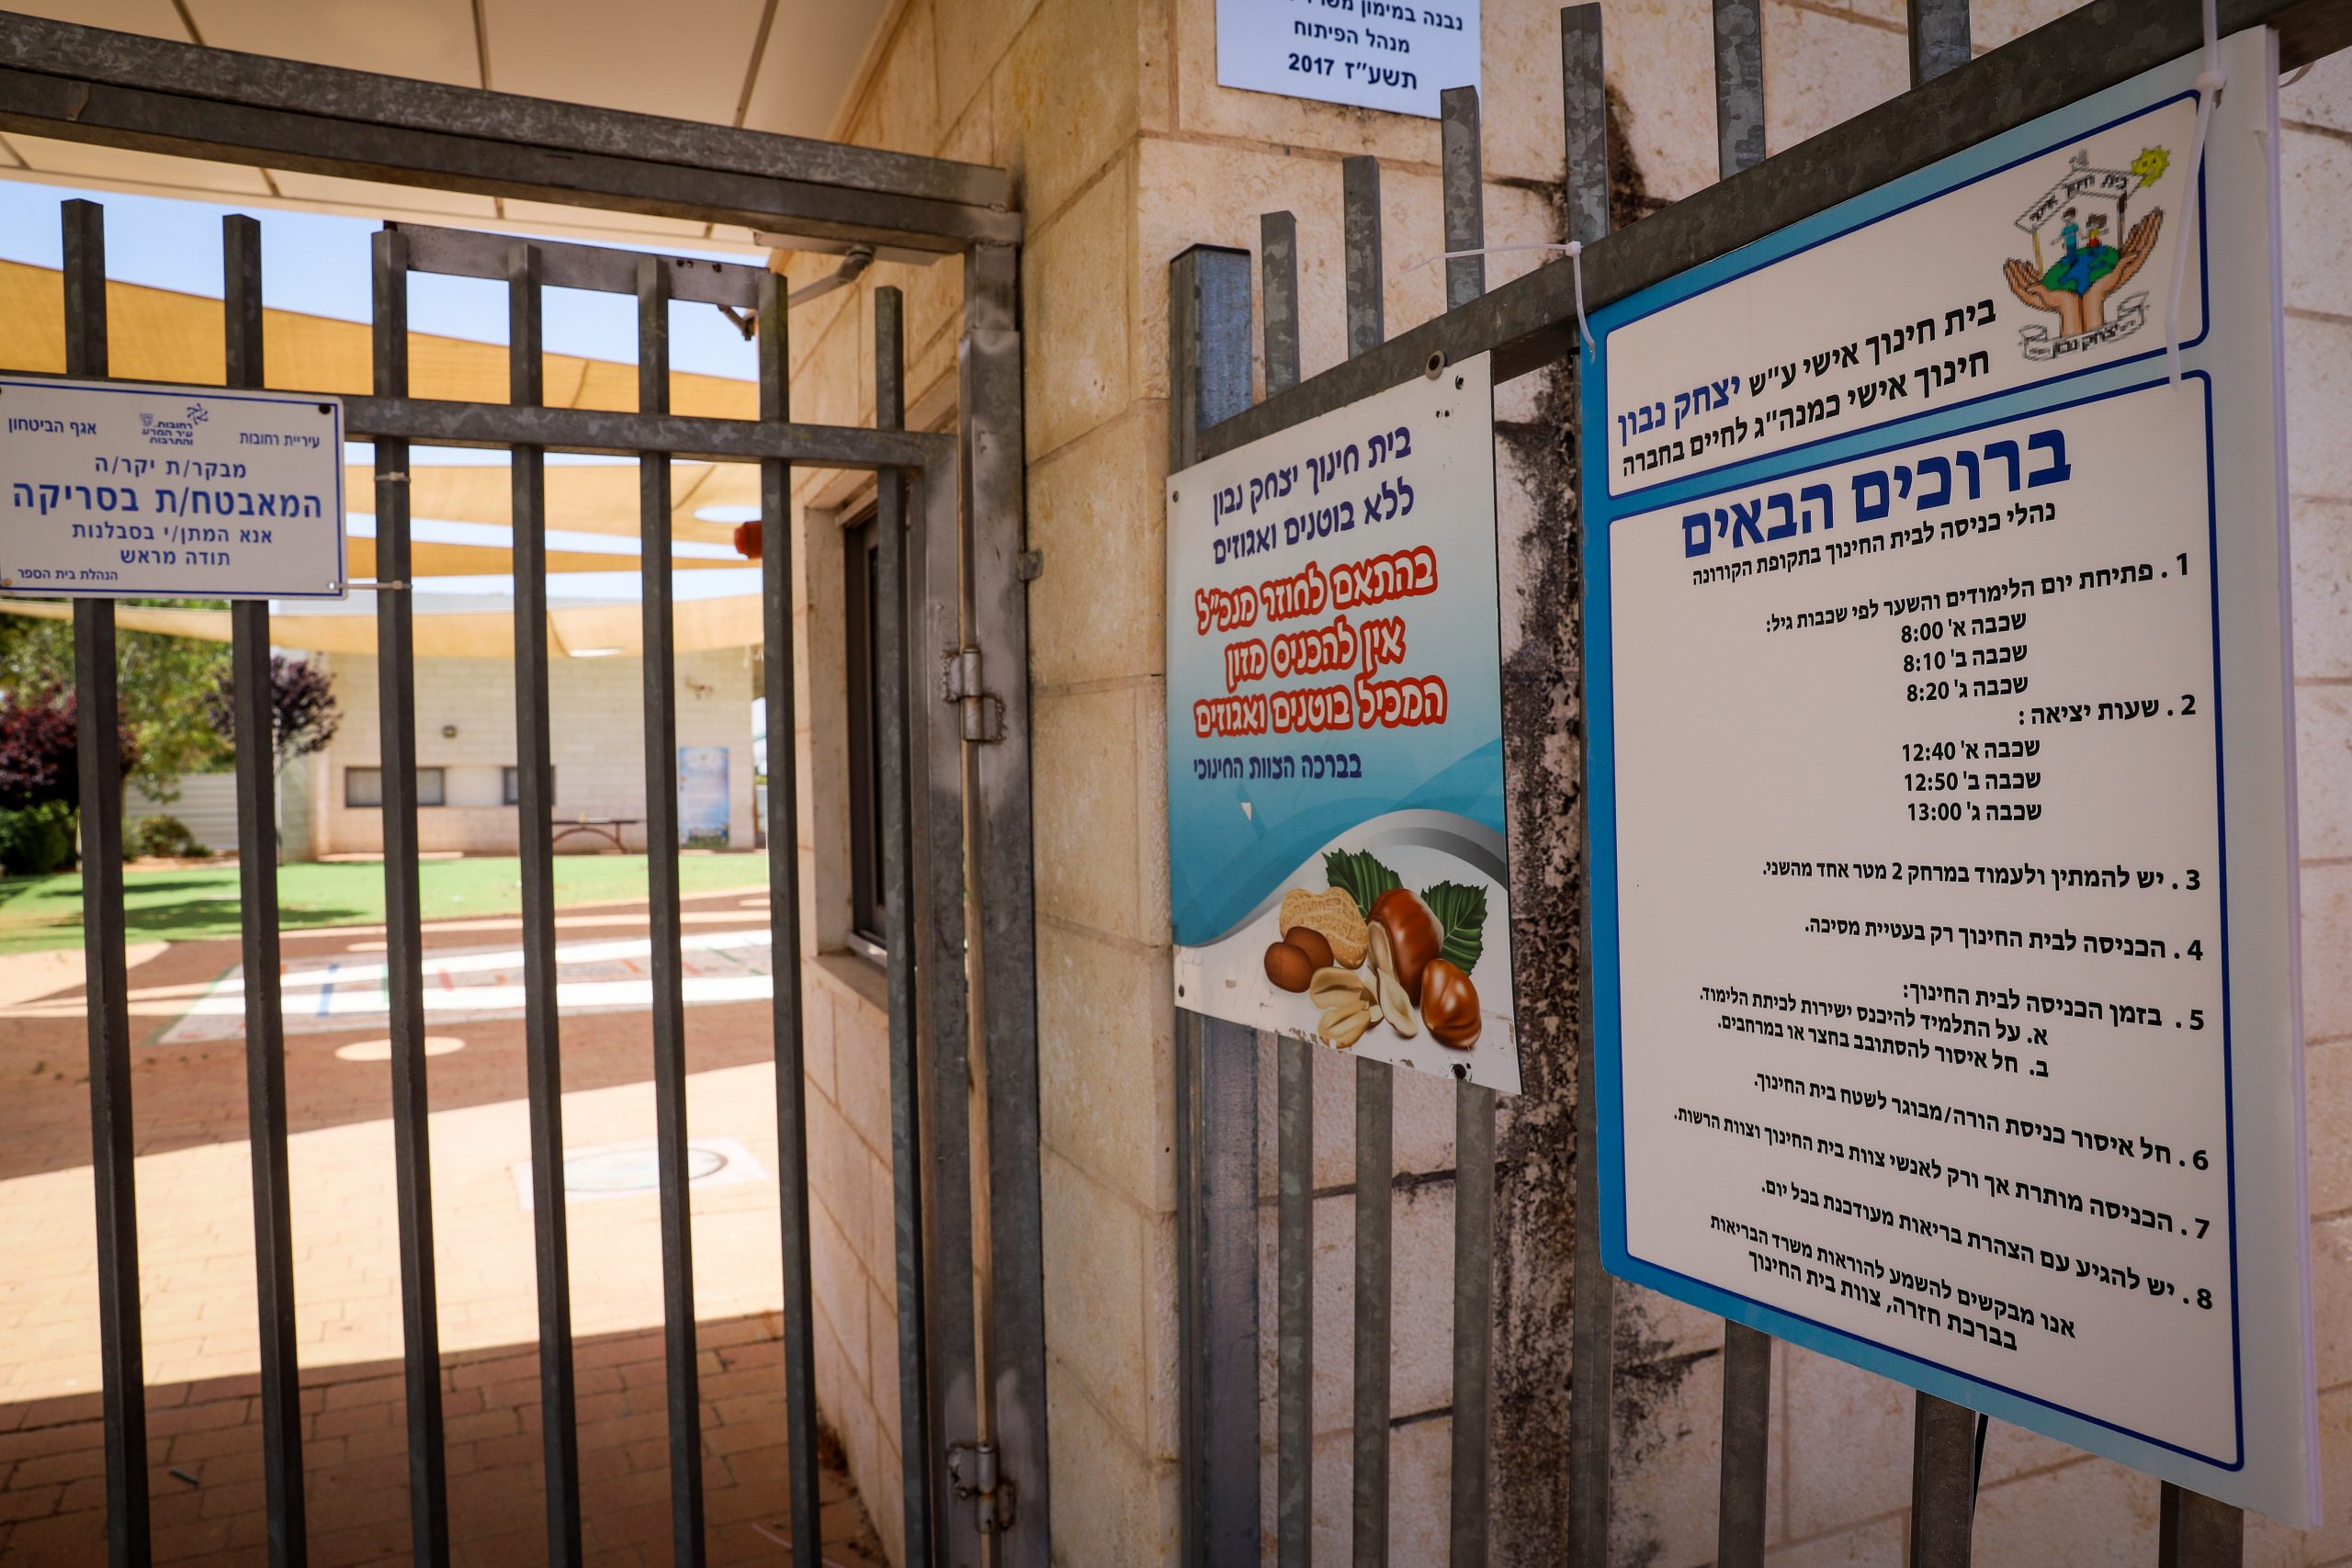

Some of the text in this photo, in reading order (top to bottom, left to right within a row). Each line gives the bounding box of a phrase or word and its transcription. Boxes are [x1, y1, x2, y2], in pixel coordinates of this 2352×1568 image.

[1361, 0, 1417, 23] במימון
[1422, 10, 1464, 32] נבנה
[1294, 19, 1410, 54] מנהל הפיתוח
[1288, 52, 1336, 77] 2017
[1944, 299, 1997, 338] בית
[1864, 317, 1936, 367] חינוך
[1803, 342, 1860, 378] אישי
[1913, 350, 1990, 400] חינוך
[1673, 375, 1741, 431] יצחק
[1847, 373, 1908, 410] אישי
[7, 417, 97, 438] אגף הביטחון
[1617, 401, 1667, 447] נבון
[1689, 415, 1748, 457] לחיים
[239, 432, 321, 449] עיריית רחובות
[1623, 440, 1686, 478] בחברה
[1212, 426, 1412, 527] בית חינוך יצחק נבון
[12, 482, 140, 516] בסריקה
[1681, 428, 2072, 559] ברוכים הבאים
[71, 520, 155, 541] בסבלנות
[1212, 475, 1415, 565] ללא בוטנים ואגוזים
[239, 529, 273, 544] אנא
[1692, 502, 2056, 586] נהלי כניסה לבית החינוך בתקופת הקורונה
[119, 548, 231, 567] תודה מראש
[17, 568, 119, 581] הנהלת בית הספר
[1329, 545, 1439, 611] בהתאם
[1260, 560, 1328, 623] לחוזר
[1766, 563, 2154, 633] פתיחת יום הלימודים והשער לפי שכבות גיל:
[1901, 612, 2027, 644] שכבה 8:00
[1224, 614, 1407, 694] אין להכניס מזון
[1903, 644, 2028, 673] שכבה 8:10
[1906, 675, 2029, 703] שכבה 8:20
[1193, 674, 1448, 739] המכיל בוטנים ואגוזים
[2030, 698, 2160, 726] שעות יציאה
[1902, 739, 2041, 762] שכבה 12:40
[1193, 752, 1363, 781] בברכה הצוות החינוכי
[1904, 772, 2041, 792] שכבה 12:50
[1907, 802, 2042, 822] שכבה 13:00
[1815, 862, 1850, 879] אחד
[1852, 863, 1887, 880] מטר
[1907, 864, 1971, 886] במרחק
[1973, 862, 2046, 886] ולעמוד
[2051, 863, 2131, 892] להמתין
[2135, 870, 2165, 889] יש
[1864, 920, 1927, 942] בעטיית
[1958, 927, 2023, 950] החינוך
[2028, 928, 2077, 952] לבית
[2083, 935, 2166, 959] הכניסה
[1751, 992, 1797, 1012] לכיתת
[1800, 998, 1853, 1019] ישירות
[1974, 987, 2021, 1010] לבית
[2026, 994, 2103, 1021] הכניסה
[1856, 1006, 1917, 1028] להיכנס
[1919, 1012, 1991, 1039] התלמיד
[2109, 1003, 2163, 1028] בזמן
[1807, 1027, 1850, 1048] בחצר
[1995, 1017, 2021, 1043] על
[1853, 1033, 1930, 1060] להסתובב
[1934, 1044, 1989, 1069] איסור
[1991, 1047, 2018, 1074] חל
[1808, 1082, 1838, 1102] בית
[1839, 1088, 1888, 1111] לשטח
[1723, 1117, 1761, 1140] וצוות
[1763, 1126, 1814, 1152] החינוך
[2005, 1117, 2066, 1145] כניסת
[1816, 1138, 1845, 1159] בית
[1848, 1145, 1886, 1168] צוות
[2070, 1129, 2135, 1158] איסור
[2139, 1135, 2172, 1165] חל
[1889, 1153, 1942, 1179] לאנשי
[1947, 1166, 1979, 1190] ורק
[1790, 1180, 1820, 1208] בכל
[2014, 1181, 2084, 1213] מותרת
[1823, 1193, 1894, 1227] מעודכנת
[2089, 1197, 2174, 1234] הכניסה
[1898, 1213, 1963, 1246] בריאות
[1967, 1231, 2035, 1265] הצהרת
[2039, 1249, 2070, 1272] עם
[1710, 1214, 2076, 1339] אנו מבקשים להשמע להוראות משרד הבריאות
[1747, 1250, 1802, 1282] החינוך
[2075, 1258, 2141, 1291] להגיע
[1805, 1268, 1837, 1293] בית
[1840, 1279, 1882, 1308] צוות
[2146, 1276, 2176, 1297] יש
[1947, 1312, 2018, 1352] בברכת
